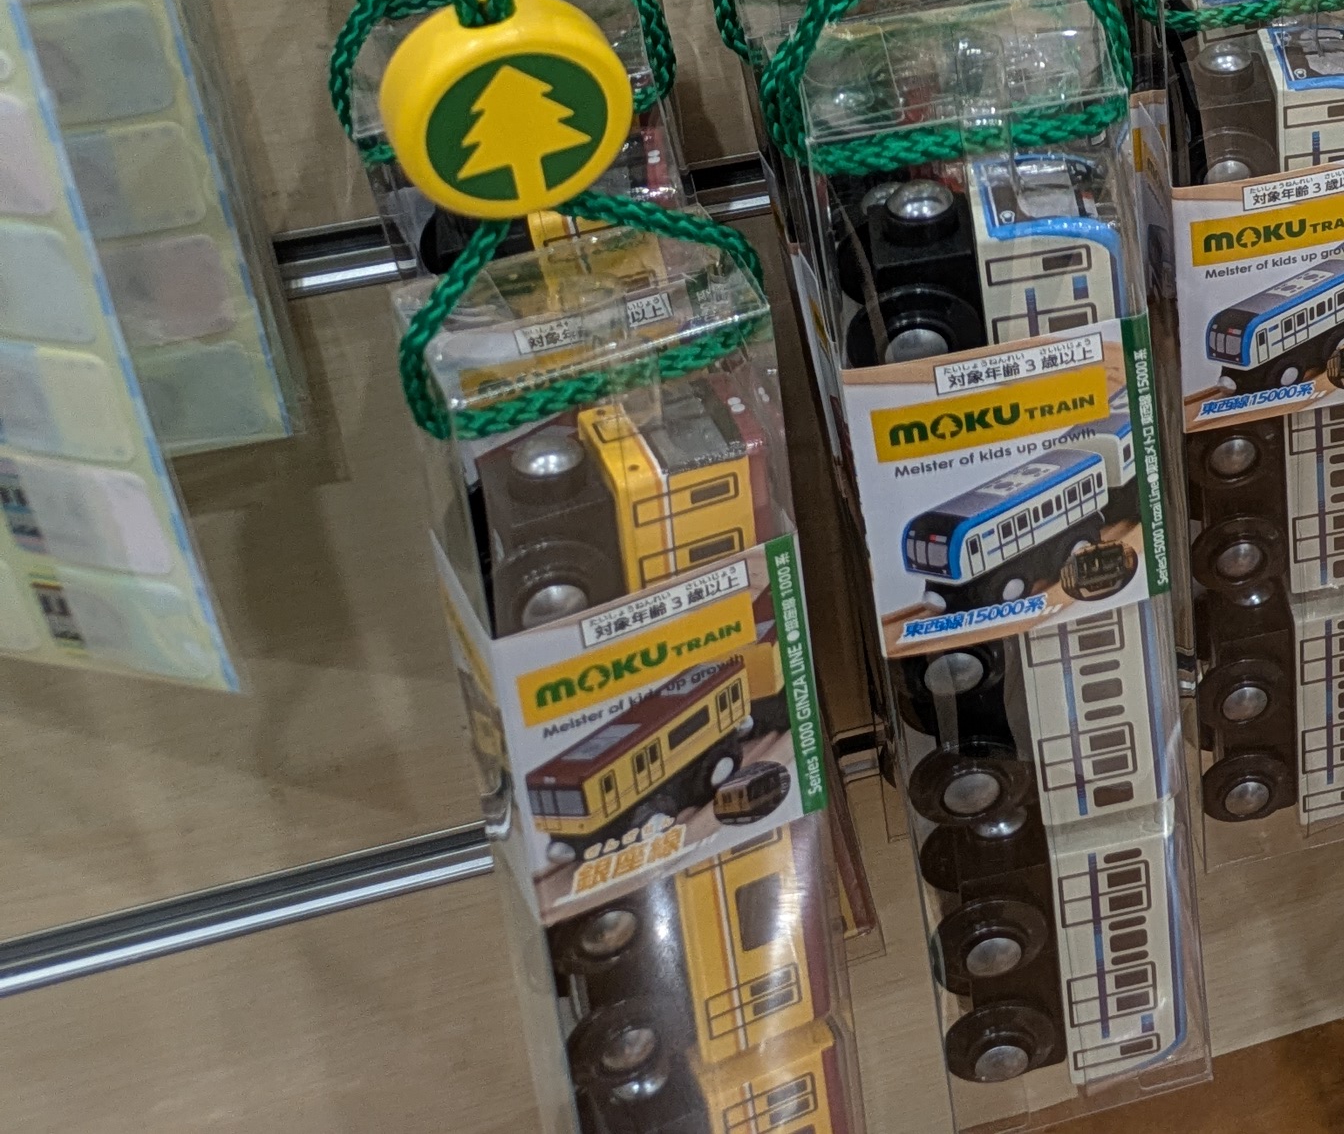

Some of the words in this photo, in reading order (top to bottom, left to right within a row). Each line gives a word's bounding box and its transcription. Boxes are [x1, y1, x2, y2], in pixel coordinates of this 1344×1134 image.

[1203, 218, 1306, 253] MOKU
[1205, 264, 1251, 279] Meister
[1256, 260, 1269, 271] of
[1272, 256, 1298, 268] kids
[1301, 252, 1317, 263] up
[889, 402, 1021, 446] MOKU
[1025, 394, 1095, 417] TRAIN
[895, 458, 953, 479] Meister
[959, 453, 975, 466] of
[979, 445, 1011, 461] kids
[1016, 440, 1037, 455] up
[1041, 428, 1096, 451] growth
[1149, 500, 1162, 529] Tozai
[672, 620, 742, 657] TRAIN
[787, 642, 805, 673] LINE
[792, 673, 811, 720] GINZA
[798, 721, 816, 754] 1000
[803, 755, 822, 795] Series
